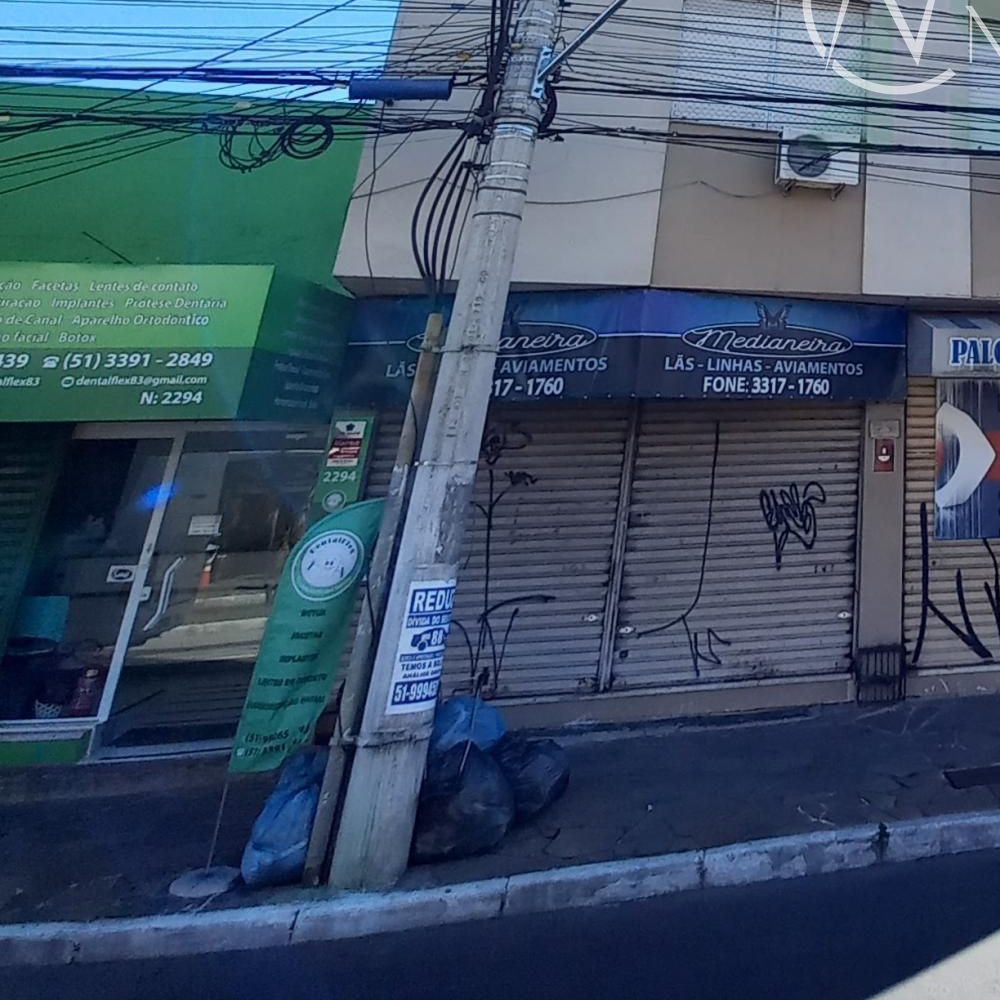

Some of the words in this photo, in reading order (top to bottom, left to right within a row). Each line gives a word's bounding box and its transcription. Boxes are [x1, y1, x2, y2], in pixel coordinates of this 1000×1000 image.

[31, 280, 79, 291] Facetas
[89, 282, 130, 292] Lentes
[133, 282, 149, 292] de
[151, 282, 198, 292] contato
[51, 298, 114, 310] Implantes
[24, 314, 63, 325] Canal
[71, 315, 130, 328] Aparelho
[14, 331, 49, 343] facial
[58, 332, 97, 343] Botox
[691, 328, 848, 353] Medianeira
[63, 353, 100, 370] (51)
[104, 353, 150, 368] 3391
[165, 352, 214, 368] 2849
[500, 356, 609, 374] AVIAMENTOS
[664, 355, 695, 371] LÃS
[706, 358, 763, 373] LINHAS
[774, 362, 864, 376] AVIAMENTOS
[526, 376, 564, 396] 1760
[703, 376, 749, 393] FONE:
[751, 377, 787, 395] 3317
[798, 378, 830, 395] 1760
[139, 391, 159, 405] N:
[161, 391, 203, 404] 2294
[323, 470, 356, 482] 2294
